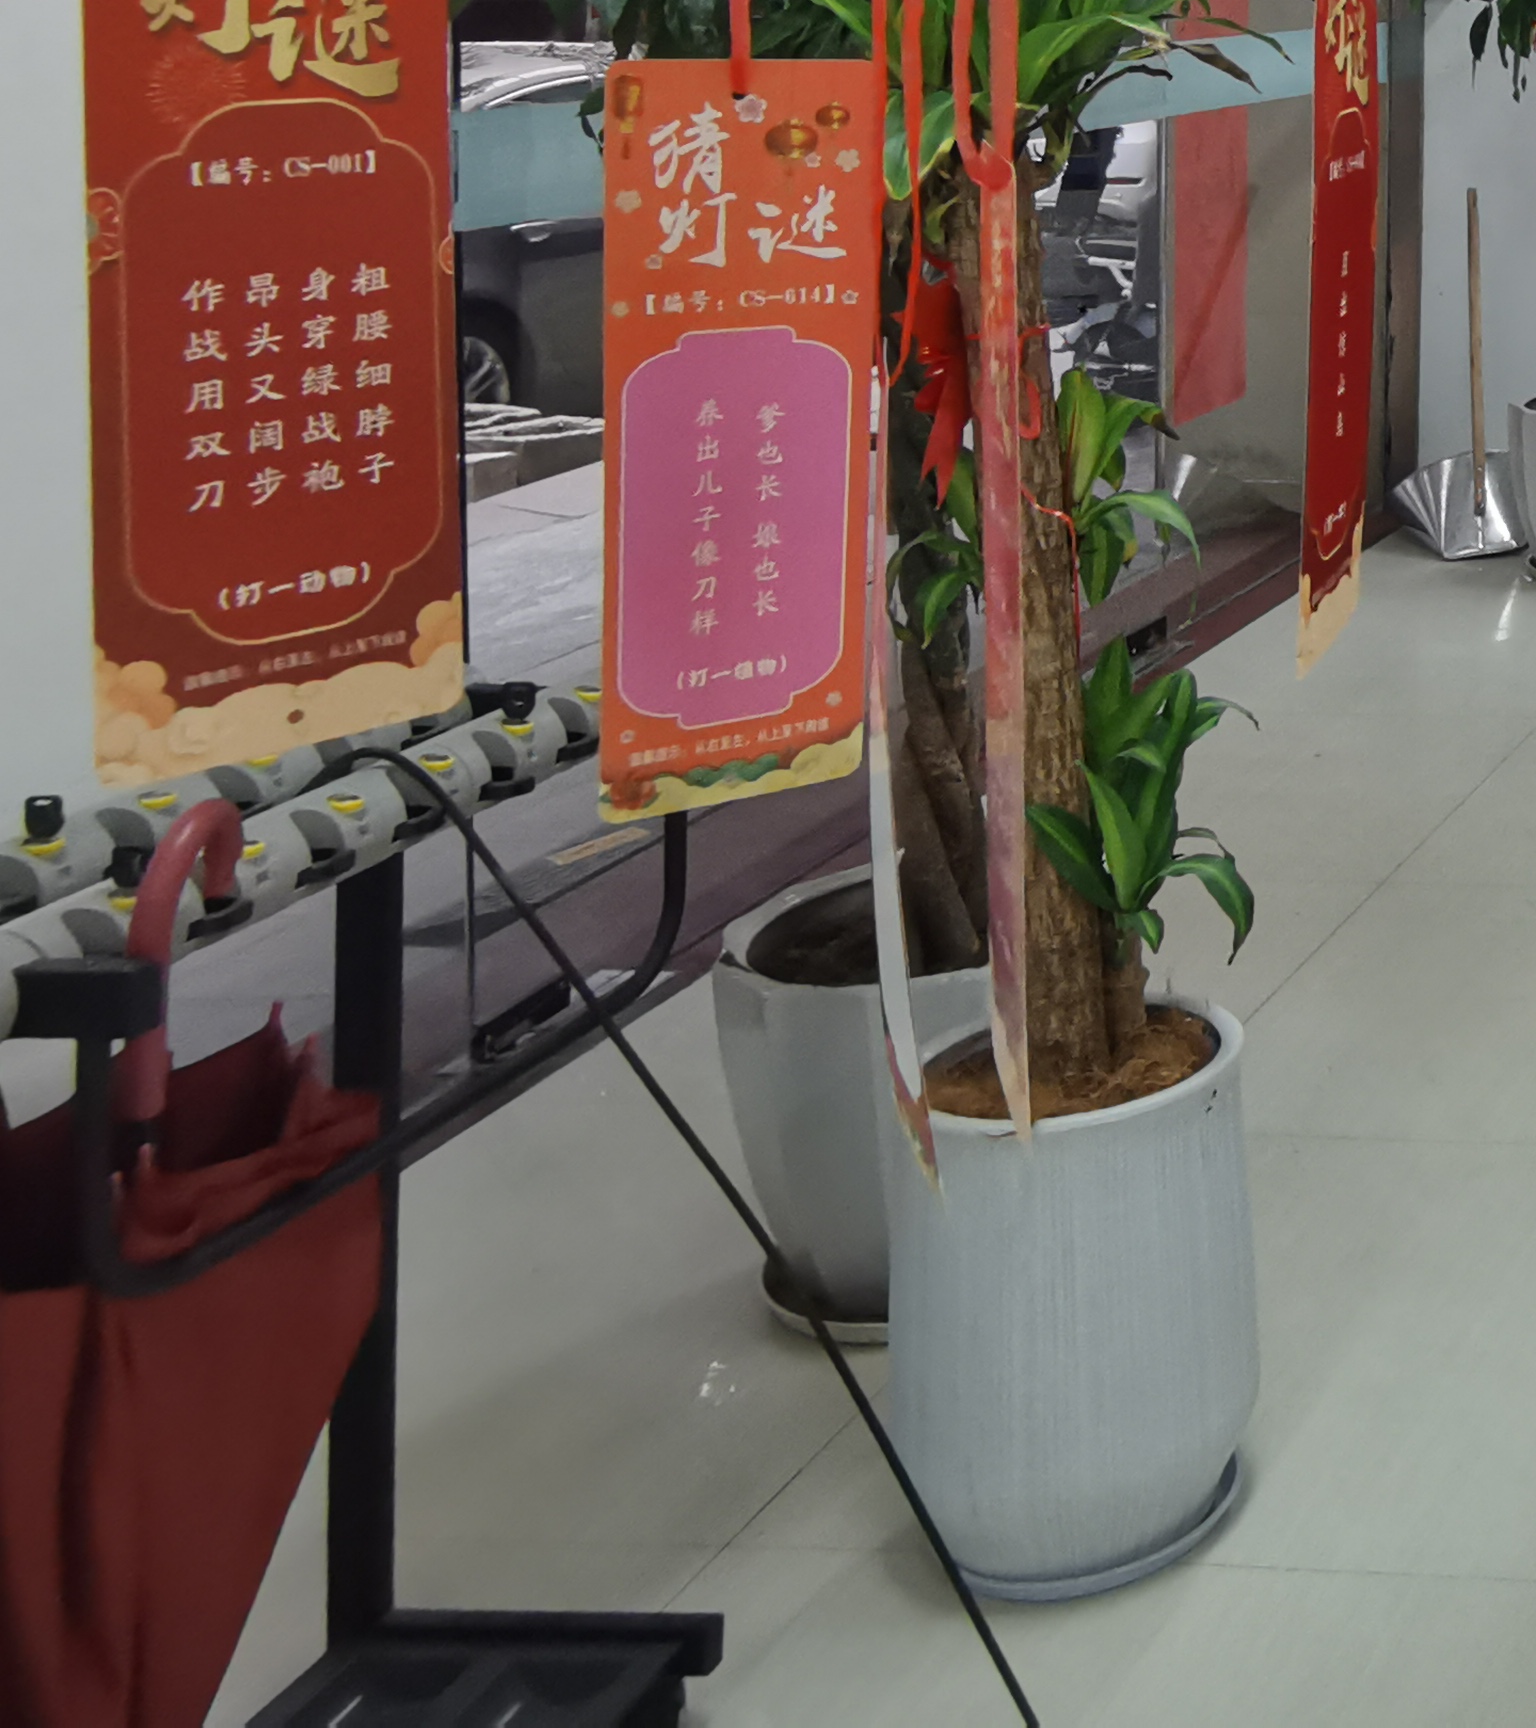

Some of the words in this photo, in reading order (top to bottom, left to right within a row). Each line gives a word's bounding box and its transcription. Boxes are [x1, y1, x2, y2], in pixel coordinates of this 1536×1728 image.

[181, 277, 231, 513] 作战用双刀
[245, 272, 287, 507] 昂头又阔步
[301, 267, 345, 493] 身穿绿战袍
[350, 262, 394, 484] 粗腰细脖子
